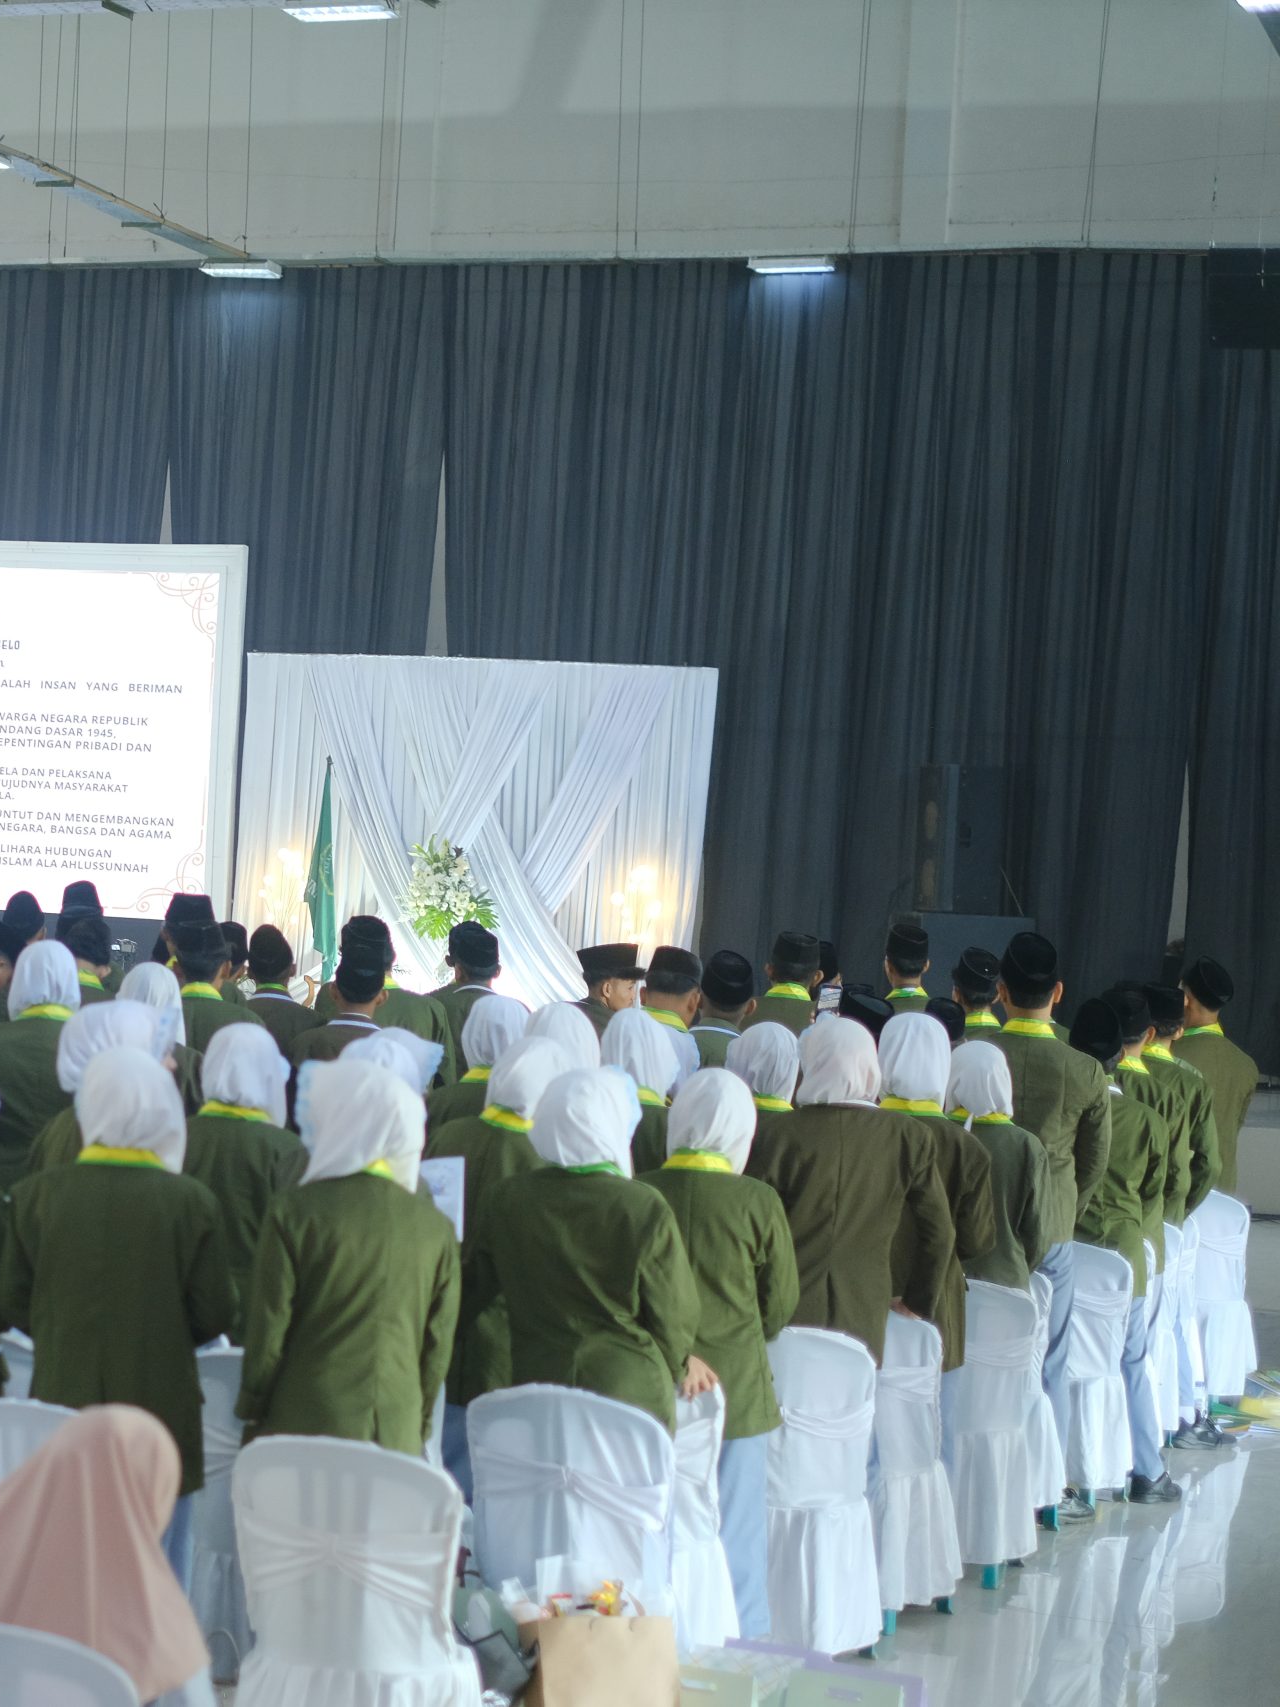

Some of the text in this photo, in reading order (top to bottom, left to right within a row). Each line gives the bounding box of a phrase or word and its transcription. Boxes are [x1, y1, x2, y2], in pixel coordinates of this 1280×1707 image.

[40, 680, 76, 689] INSAN
[86, 682, 118, 691] YANG
[128, 683, 182, 693] BERIMAN
[40, 713, 87, 723] NEGARA
[91, 715, 148, 725] REPUBLIK
[45, 726, 82, 736] DASAR
[87, 728, 116, 738] 1945,
[75, 740, 122, 750] PRIBADI
[126, 742, 151, 752] DAN
[21, 767, 44, 776] DAN
[48, 768, 111, 779] PELAKSANA
[54, 781, 128, 792] MASYARAKAT
[36, 811, 60, 820] DAN
[64, 813, 174, 826] MENGEMBANGKAN
[50, 824, 96, 835] BANGSA
[100, 827, 125, 836] DAN
[128, 829, 171, 839] AGAMA
[44, 846, 111, 858] HUBUNGAN
[35, 858, 57, 867] ALA
[60, 860, 148, 872] AHLUSSUNNAH
